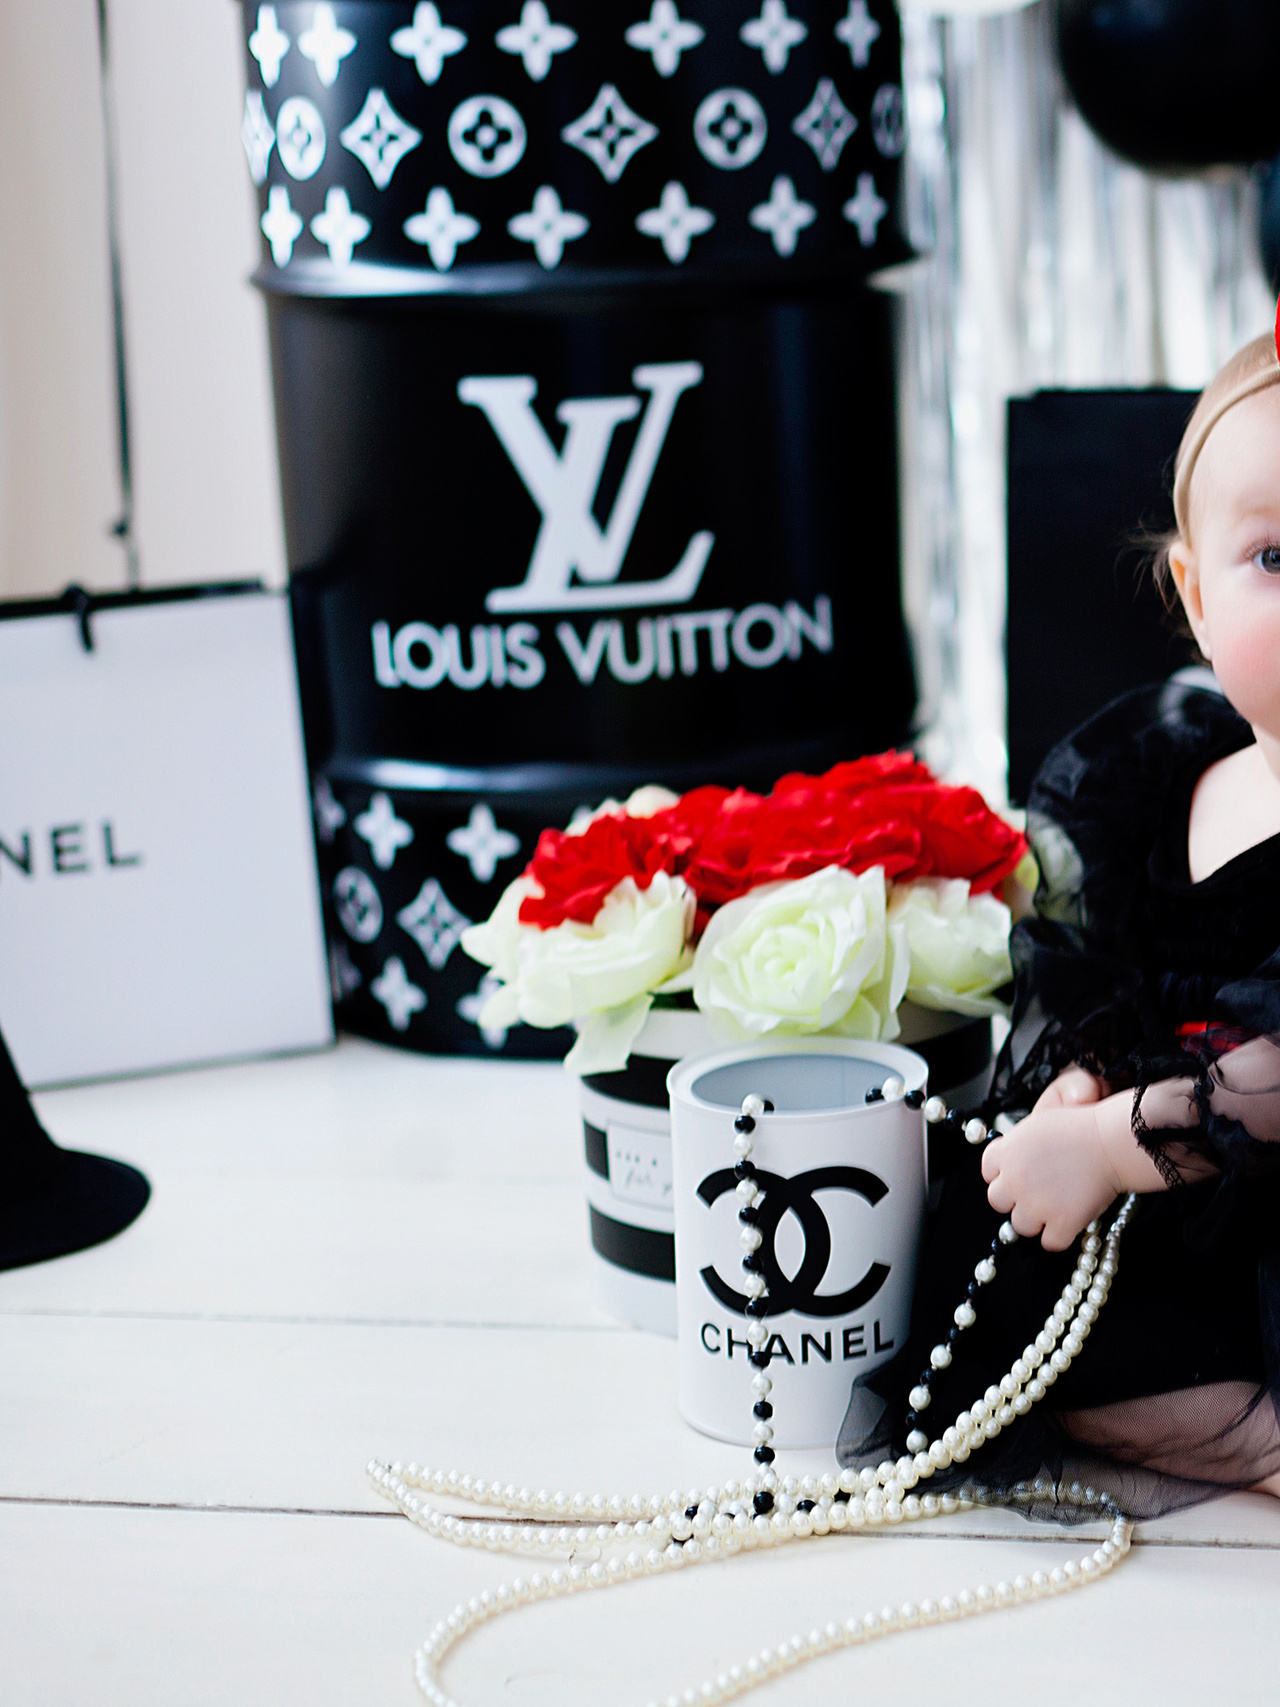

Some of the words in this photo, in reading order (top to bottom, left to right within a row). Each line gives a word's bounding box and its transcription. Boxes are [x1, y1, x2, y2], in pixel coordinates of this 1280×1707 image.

[371, 619, 547, 690] LOUIS
[555, 593, 834, 687] VUITTON
[700, 1320, 896, 1366] CHANEL
